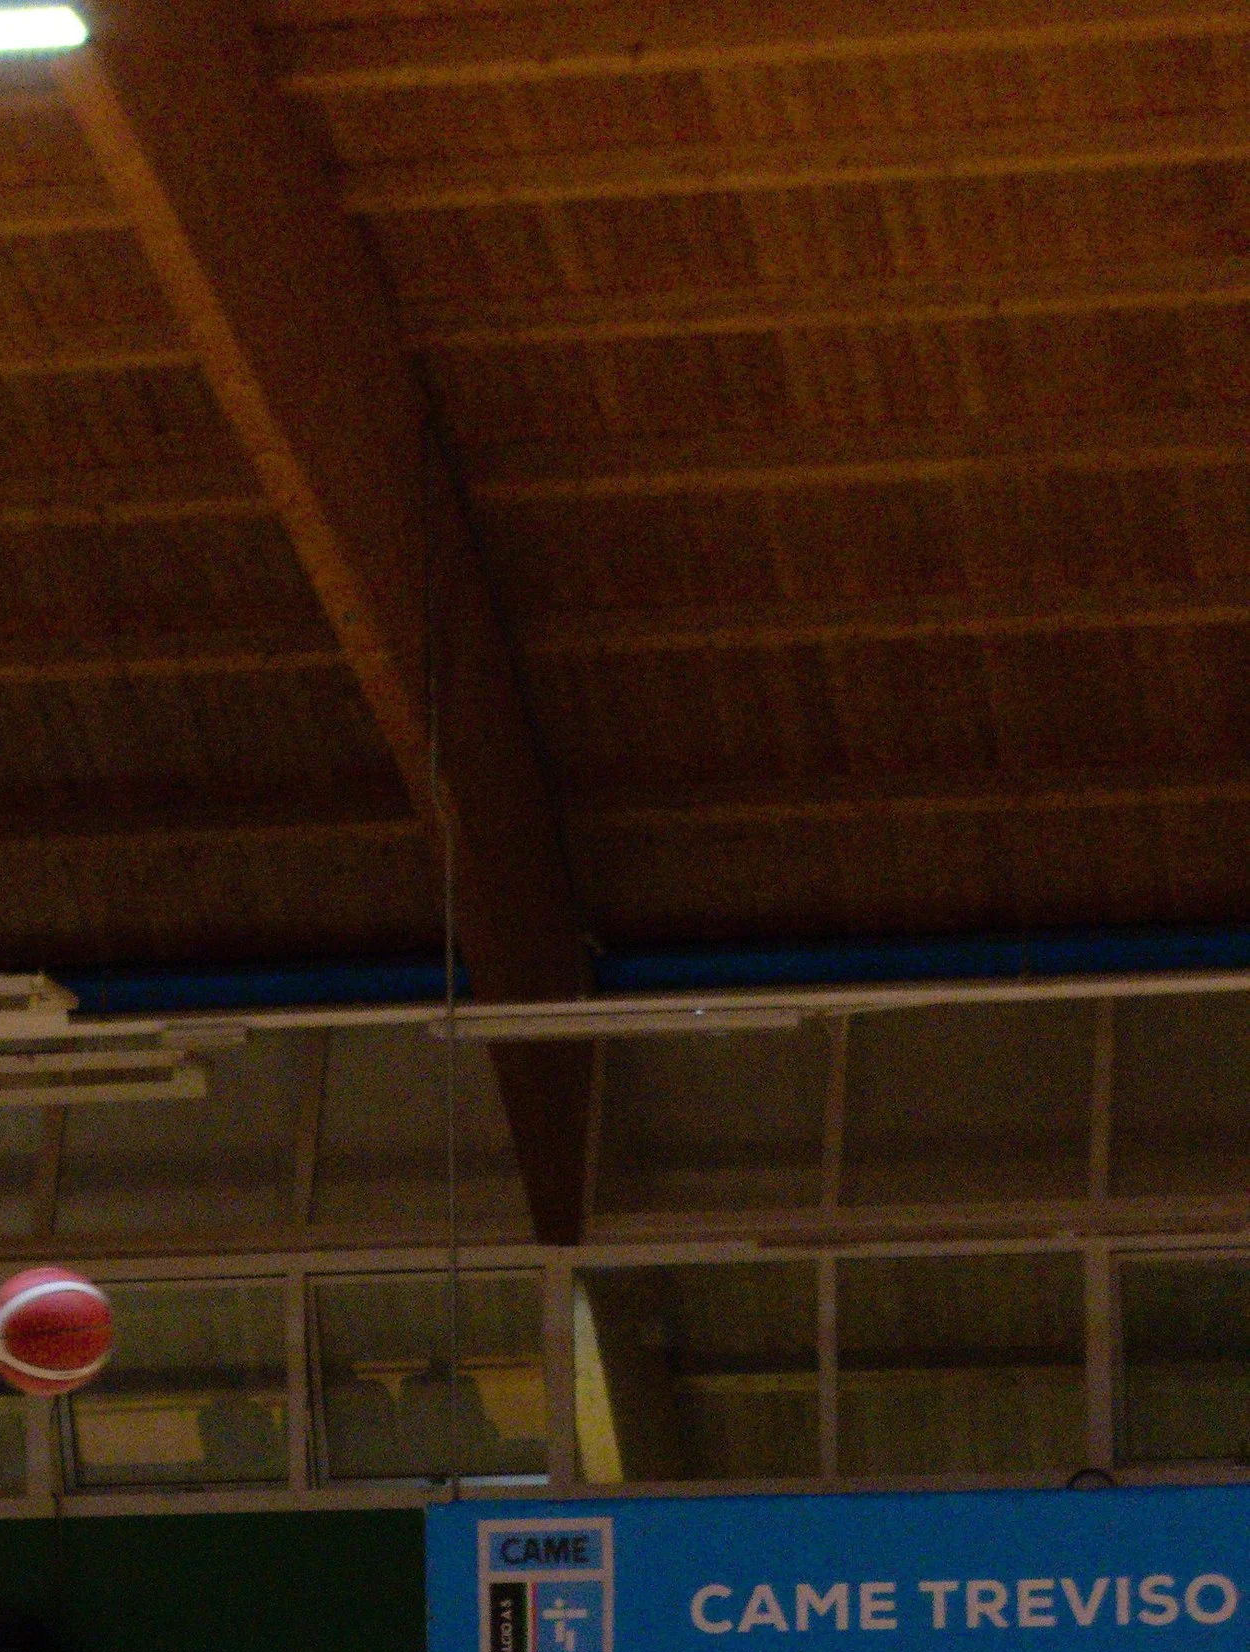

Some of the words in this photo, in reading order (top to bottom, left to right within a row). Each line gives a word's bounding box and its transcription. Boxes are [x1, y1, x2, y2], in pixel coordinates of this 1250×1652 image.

[500, 1535, 591, 1566] CAME
[689, 1582, 898, 1635] CAME
[917, 1573, 1240, 1630] TREVISO
